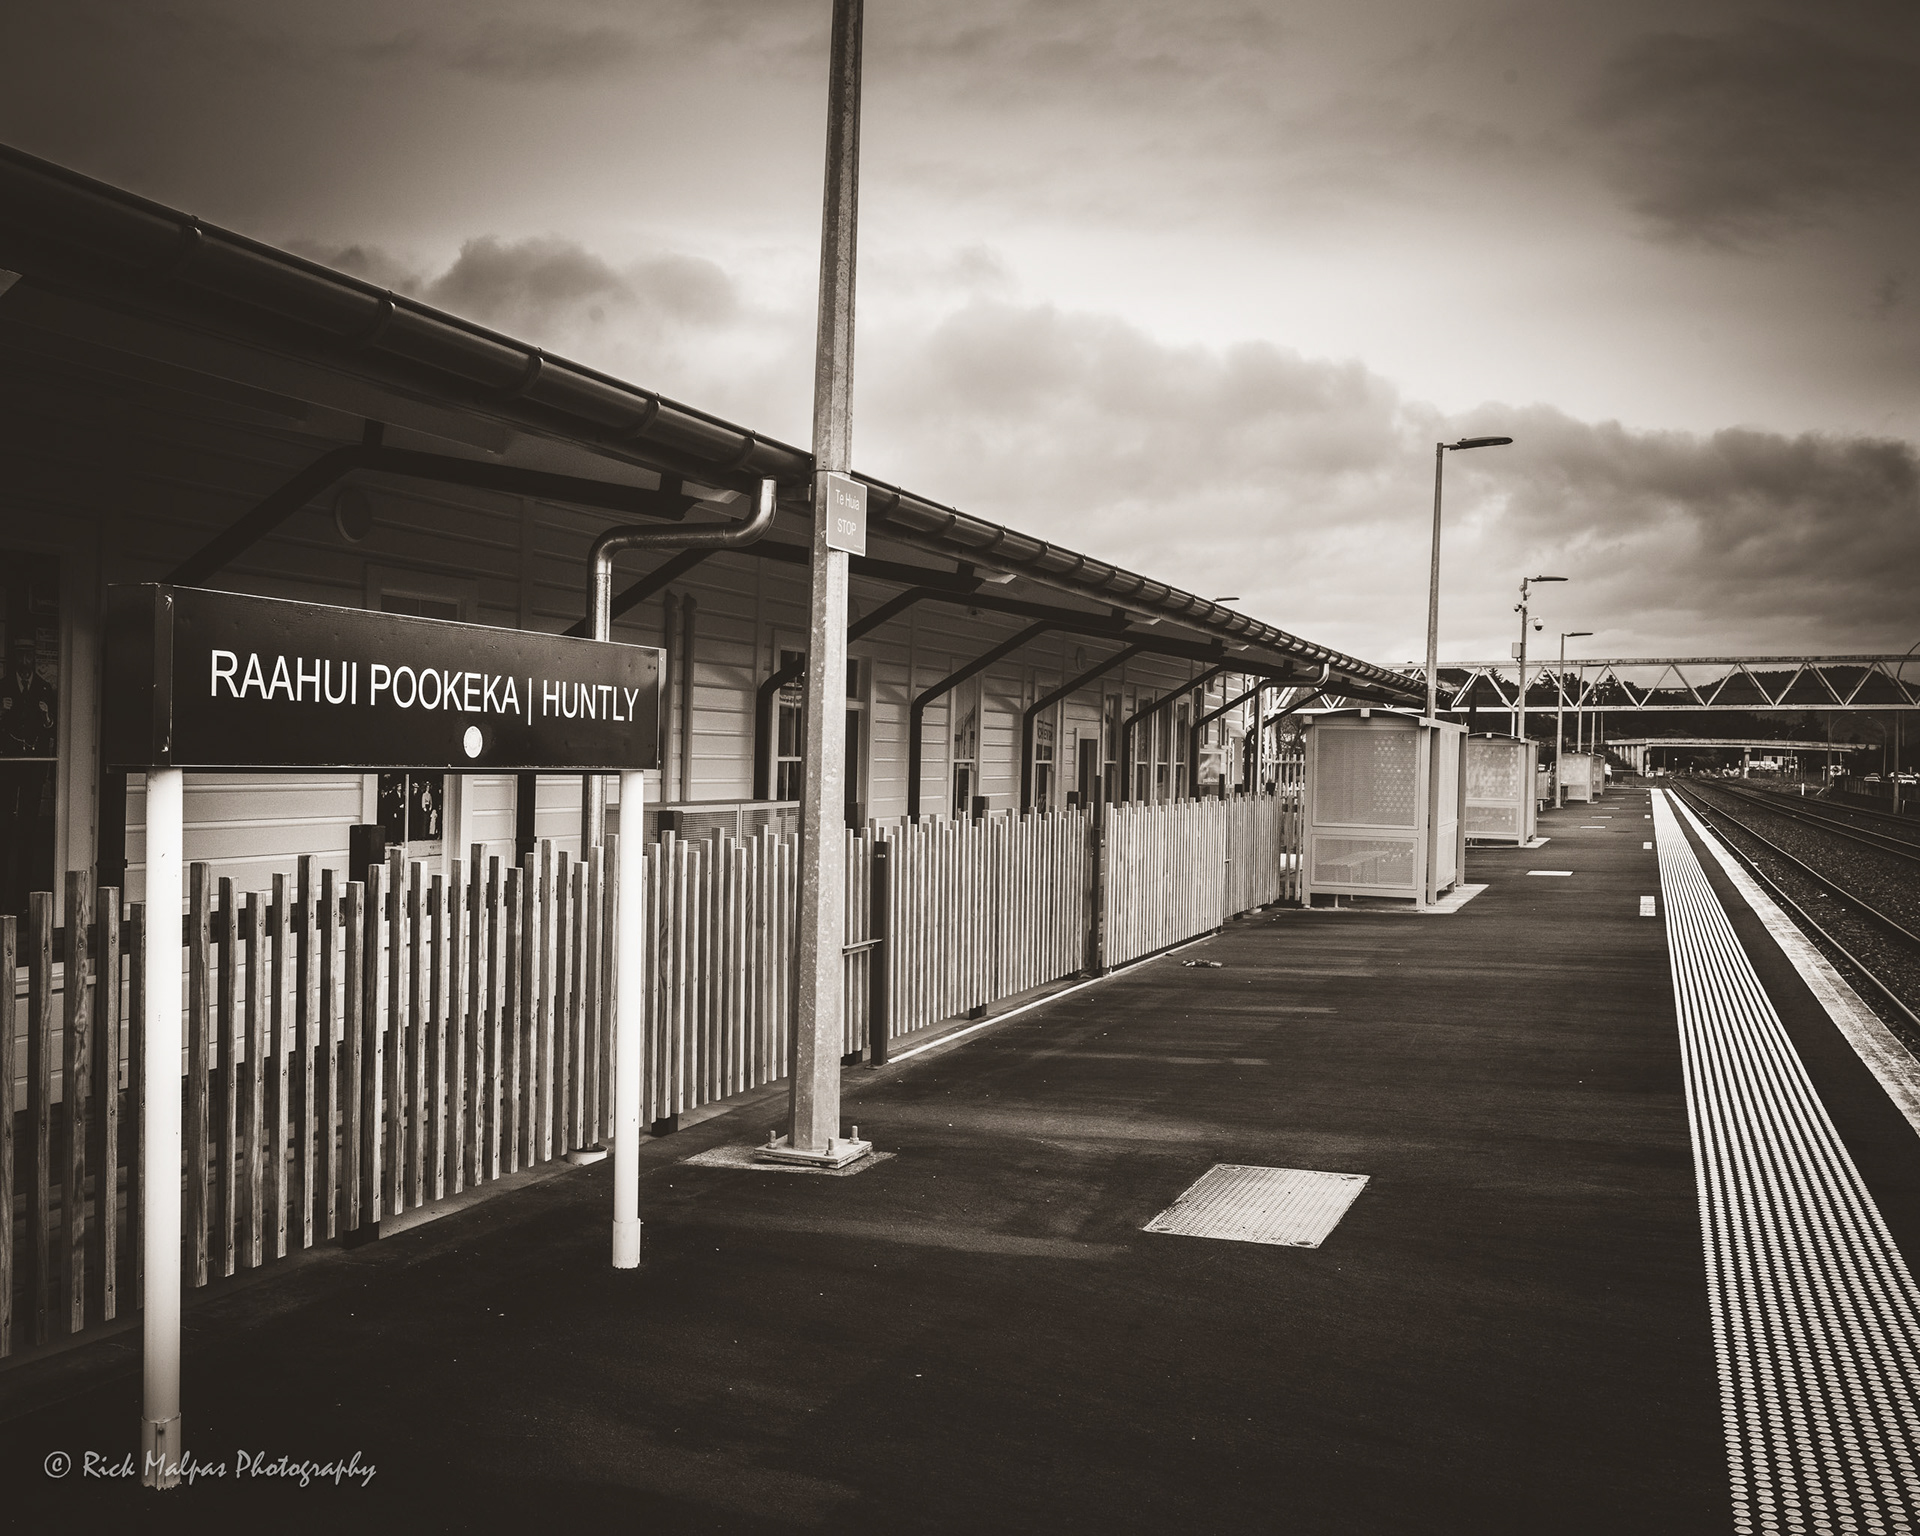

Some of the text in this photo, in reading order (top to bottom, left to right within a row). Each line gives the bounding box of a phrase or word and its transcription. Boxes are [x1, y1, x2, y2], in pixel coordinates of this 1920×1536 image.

[835, 489, 860, 511] Te Huia
[837, 518, 857, 535] STOP
[211, 649, 357, 704] RAAHUI
[370, 663, 520, 715] POOKEKA
[543, 679, 639, 722] HUNTLY
